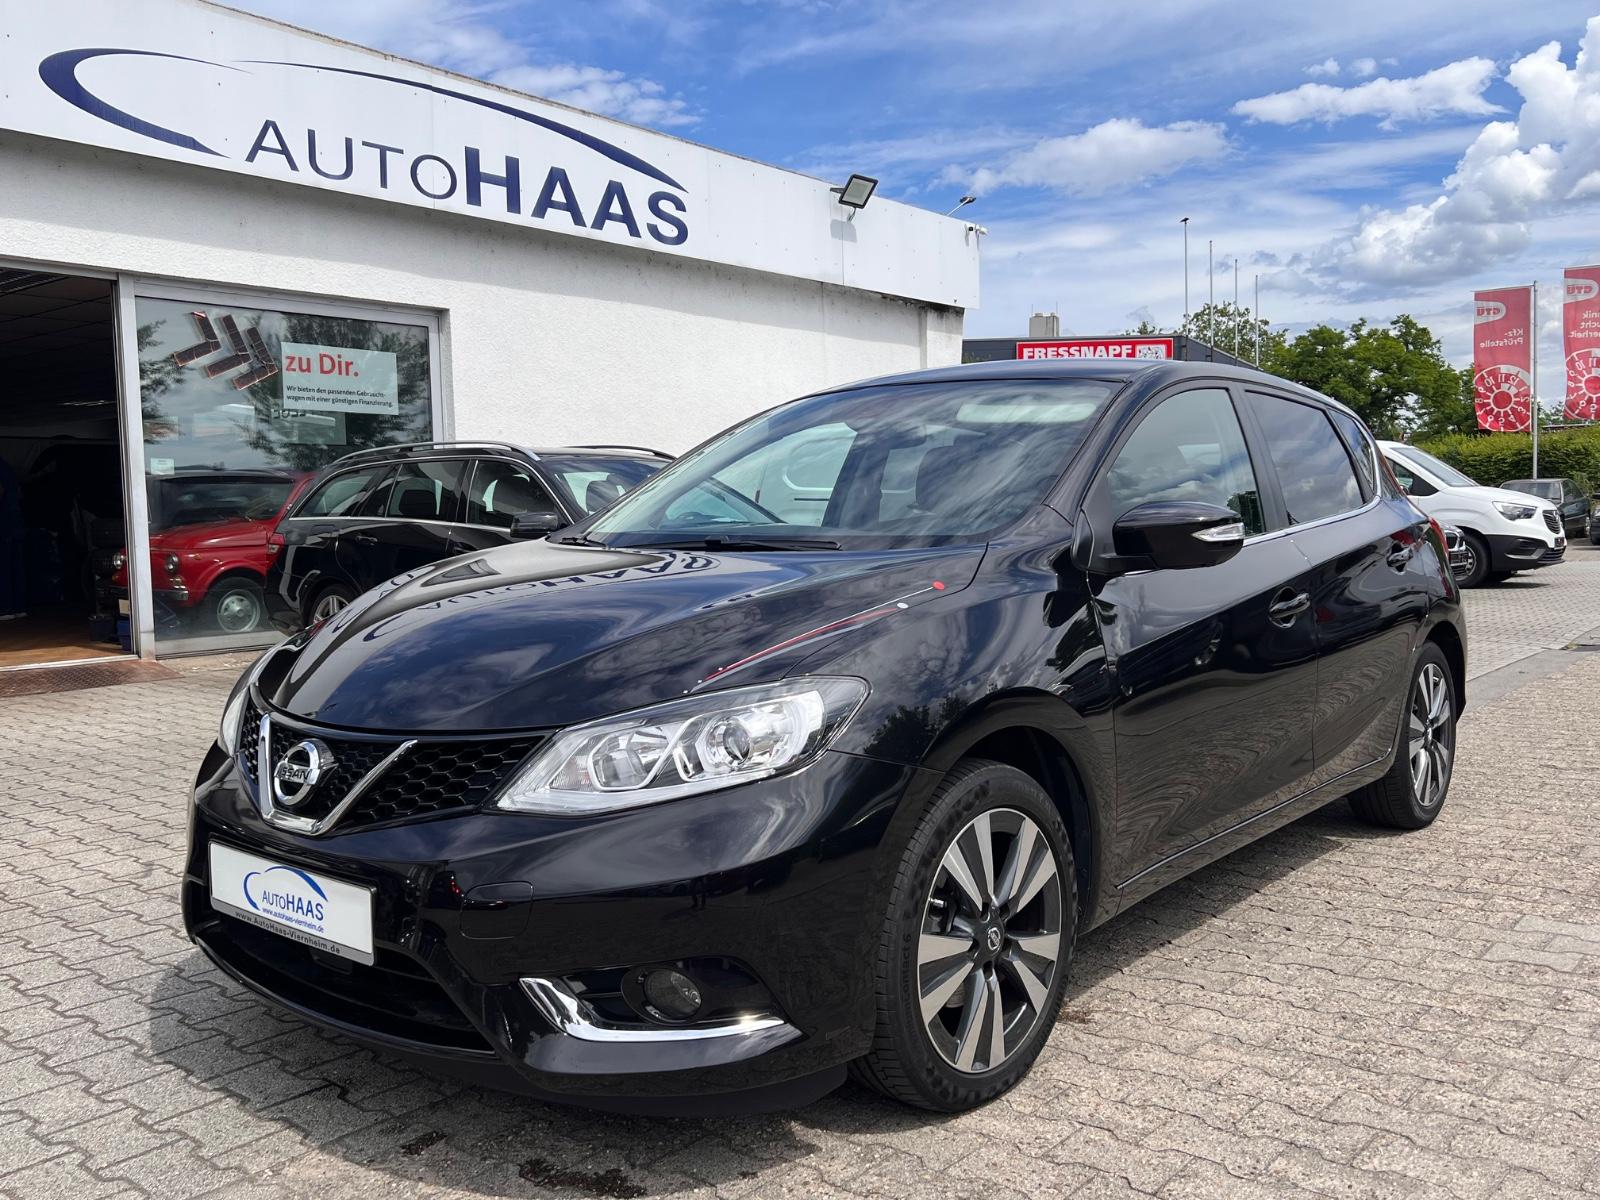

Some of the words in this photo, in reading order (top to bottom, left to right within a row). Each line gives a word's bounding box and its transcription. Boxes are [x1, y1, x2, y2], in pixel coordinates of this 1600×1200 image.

[245, 119, 689, 245] AUTOHAAS
[1023, 345, 1132, 359] FRESSNAPF
[285, 355, 311, 373] zu
[319, 353, 359, 377] Dir.
[327, 388, 355, 396] passenden
[331, 397, 359, 405] günstigen
[262, 907, 324, 933] www.autohaas-viernheim.de
[235, 911, 341, 954] www.AutoHaas-Viernheim.de
